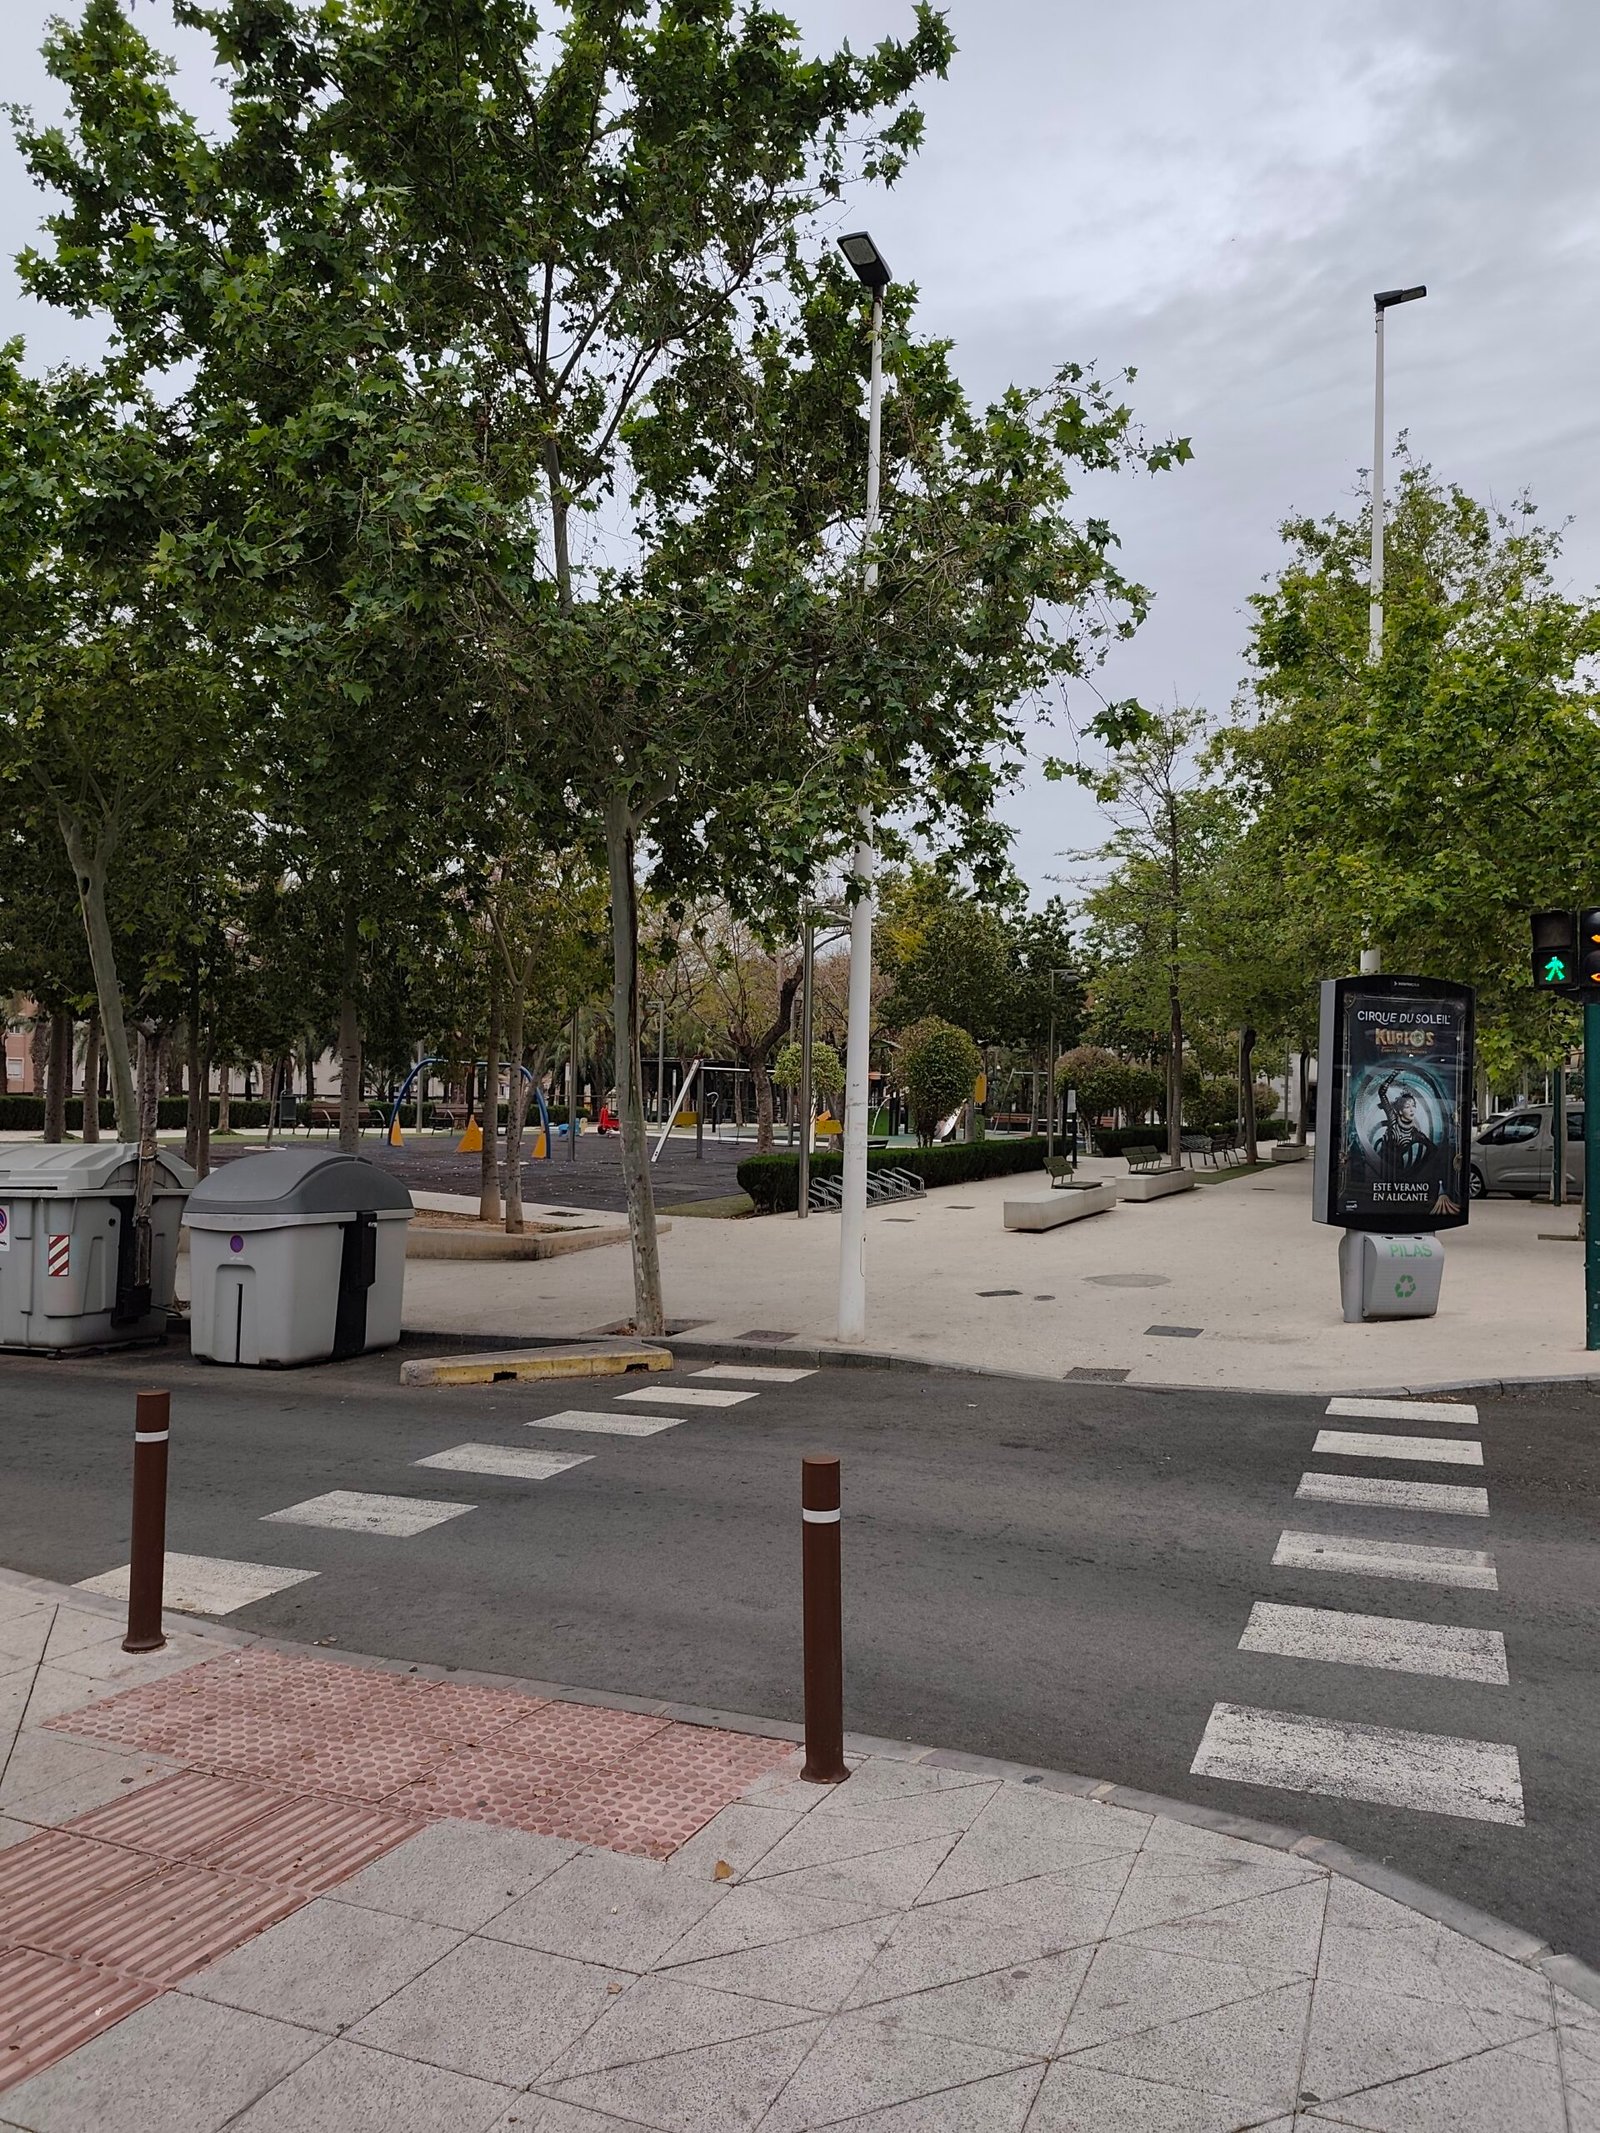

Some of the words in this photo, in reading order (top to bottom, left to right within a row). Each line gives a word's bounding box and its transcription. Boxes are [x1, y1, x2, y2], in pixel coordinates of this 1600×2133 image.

[1357, 1010, 1398, 1025] CIRQUE
[1400, 1013, 1414, 1024] DU
[1415, 1013, 1451, 1025] SOLEIL
[1373, 1182, 1392, 1191] ESTE
[1393, 1182, 1430, 1192] VERANO
[1372, 1192, 1385, 1201] EN
[1386, 1192, 1429, 1202] ALICANTE
[1390, 1243, 1433, 1258] PILAS
